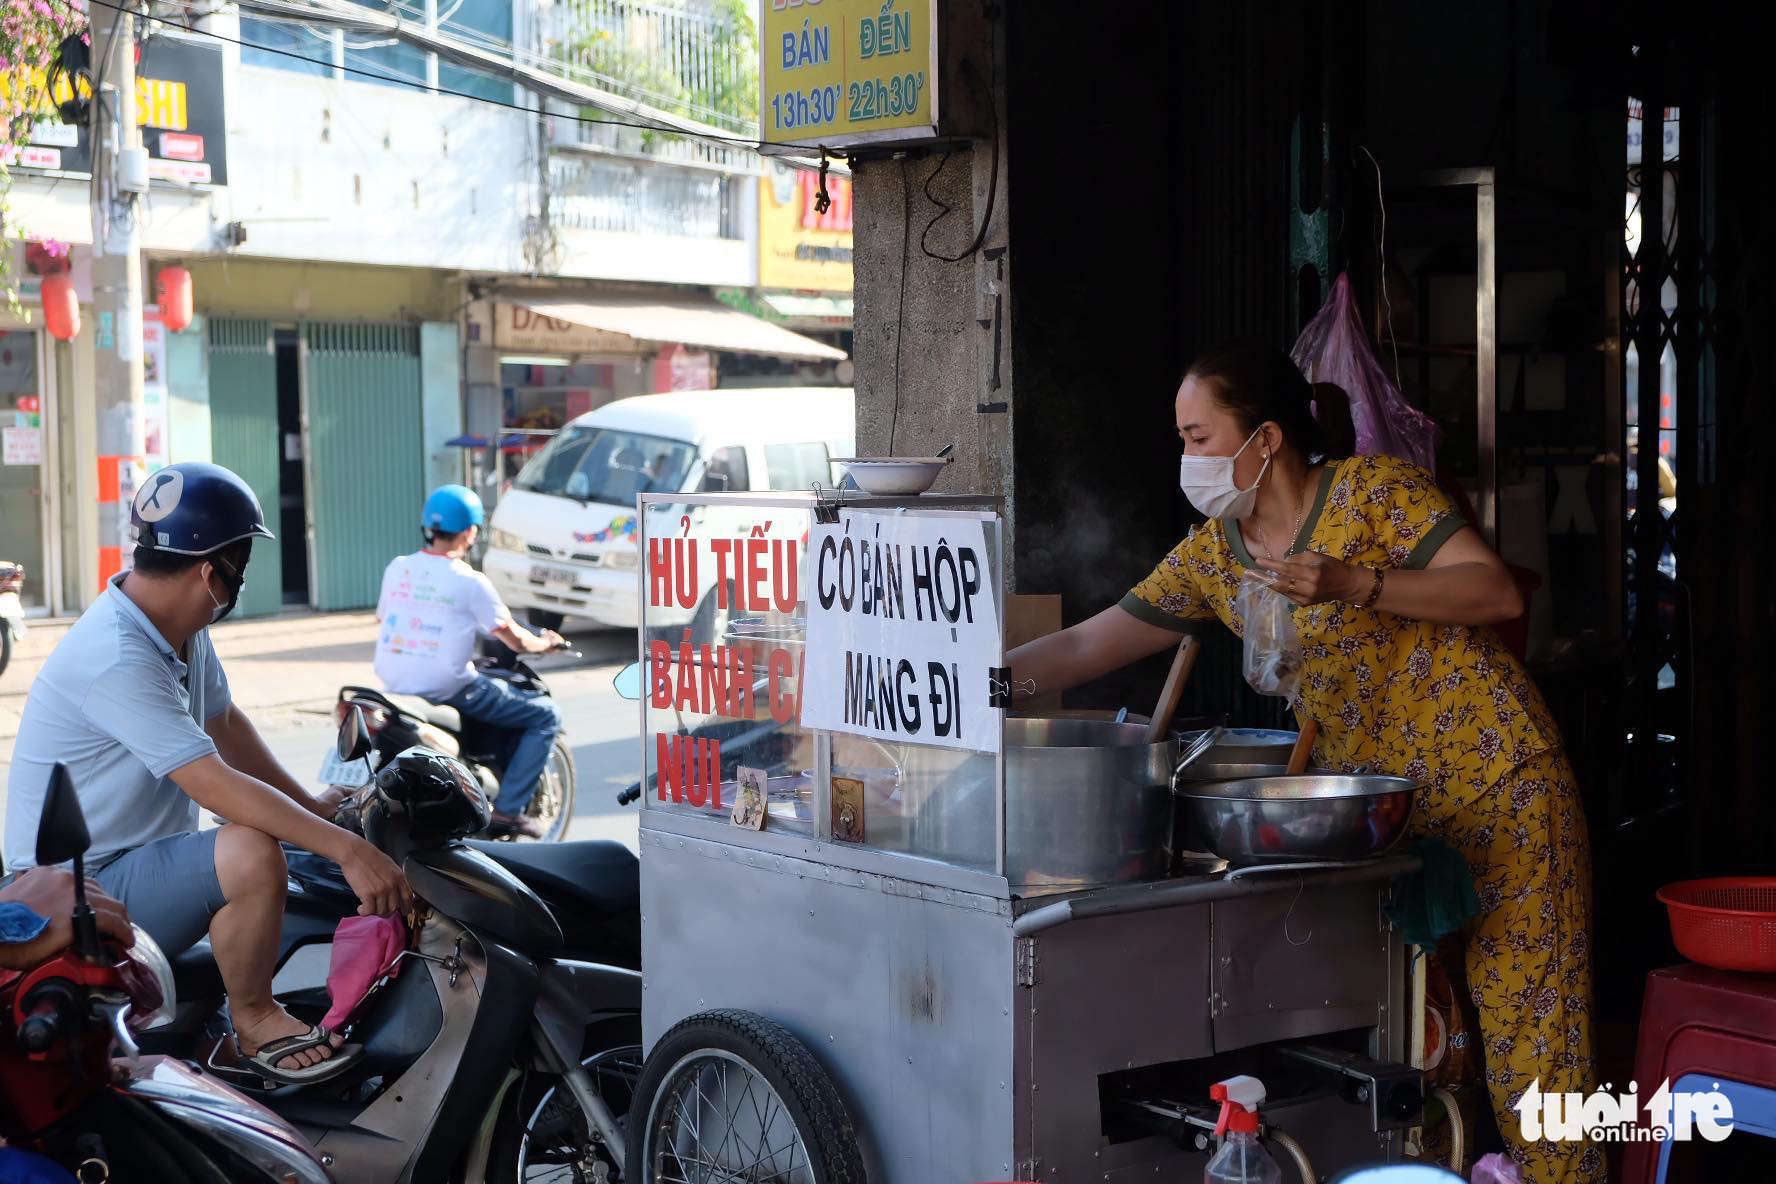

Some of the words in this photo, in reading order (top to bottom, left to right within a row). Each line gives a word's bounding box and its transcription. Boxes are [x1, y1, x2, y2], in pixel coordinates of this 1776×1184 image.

[782, 16, 829, 69] BÁN
[860, 0, 911, 58] ĐẾN
[649, 515, 698, 610] HỦ
[711, 520, 798, 614] TIẾU
[817, 518, 855, 612] CÓ
[862, 522, 905, 620] BÁN
[911, 537, 982, 643] HỘP
[651, 628, 754, 721] BÁNH
[844, 650, 922, 736] MANG
[927, 660, 962, 739] ĐI
[657, 733, 721, 810] NUI
